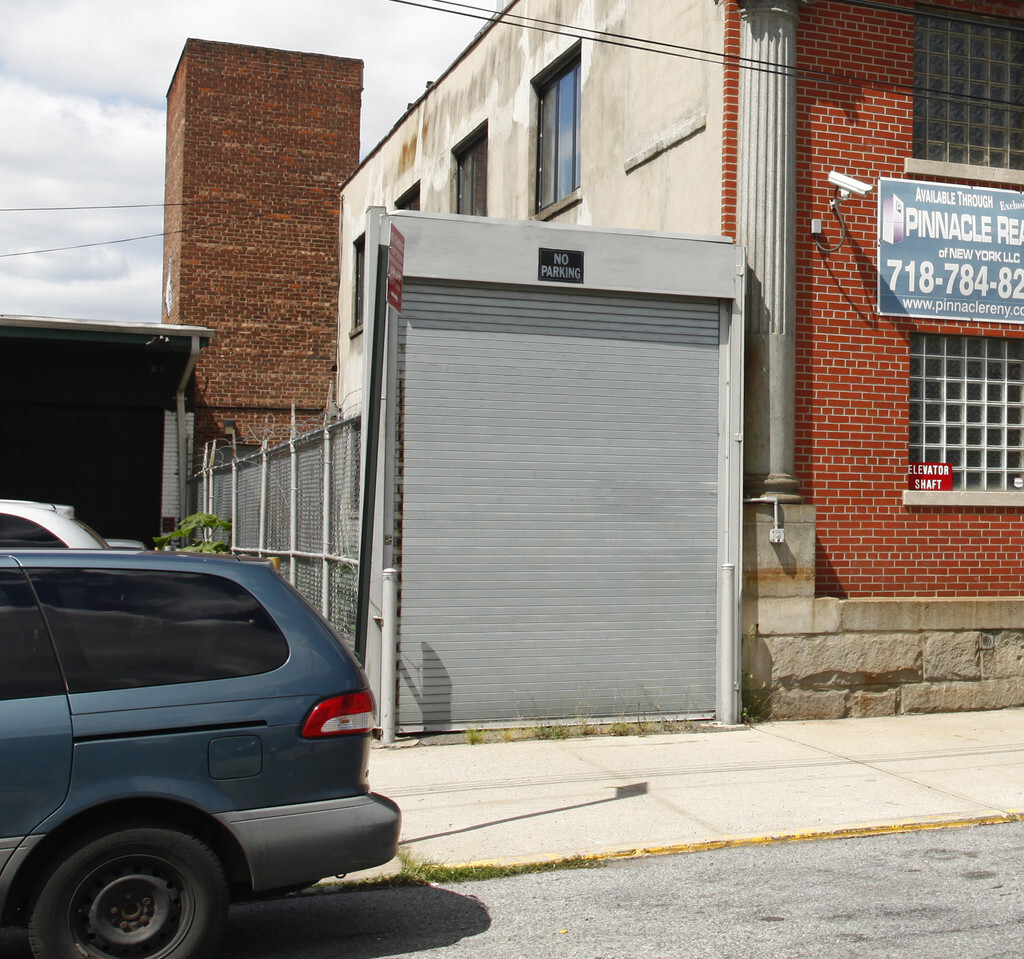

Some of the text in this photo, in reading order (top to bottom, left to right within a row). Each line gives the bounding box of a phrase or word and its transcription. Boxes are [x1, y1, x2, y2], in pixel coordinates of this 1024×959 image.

[916, 187, 993, 208] AVAILABLE THROUGH
[906, 207, 992, 243] PINNACLE
[554, 253, 569, 265] NO
[939, 248, 1020, 264] of NEW YORK LLC
[542, 265, 580, 278] PARKING
[908, 464, 949, 476] ELEVATOR
[915, 479, 942, 489] SHAFT
